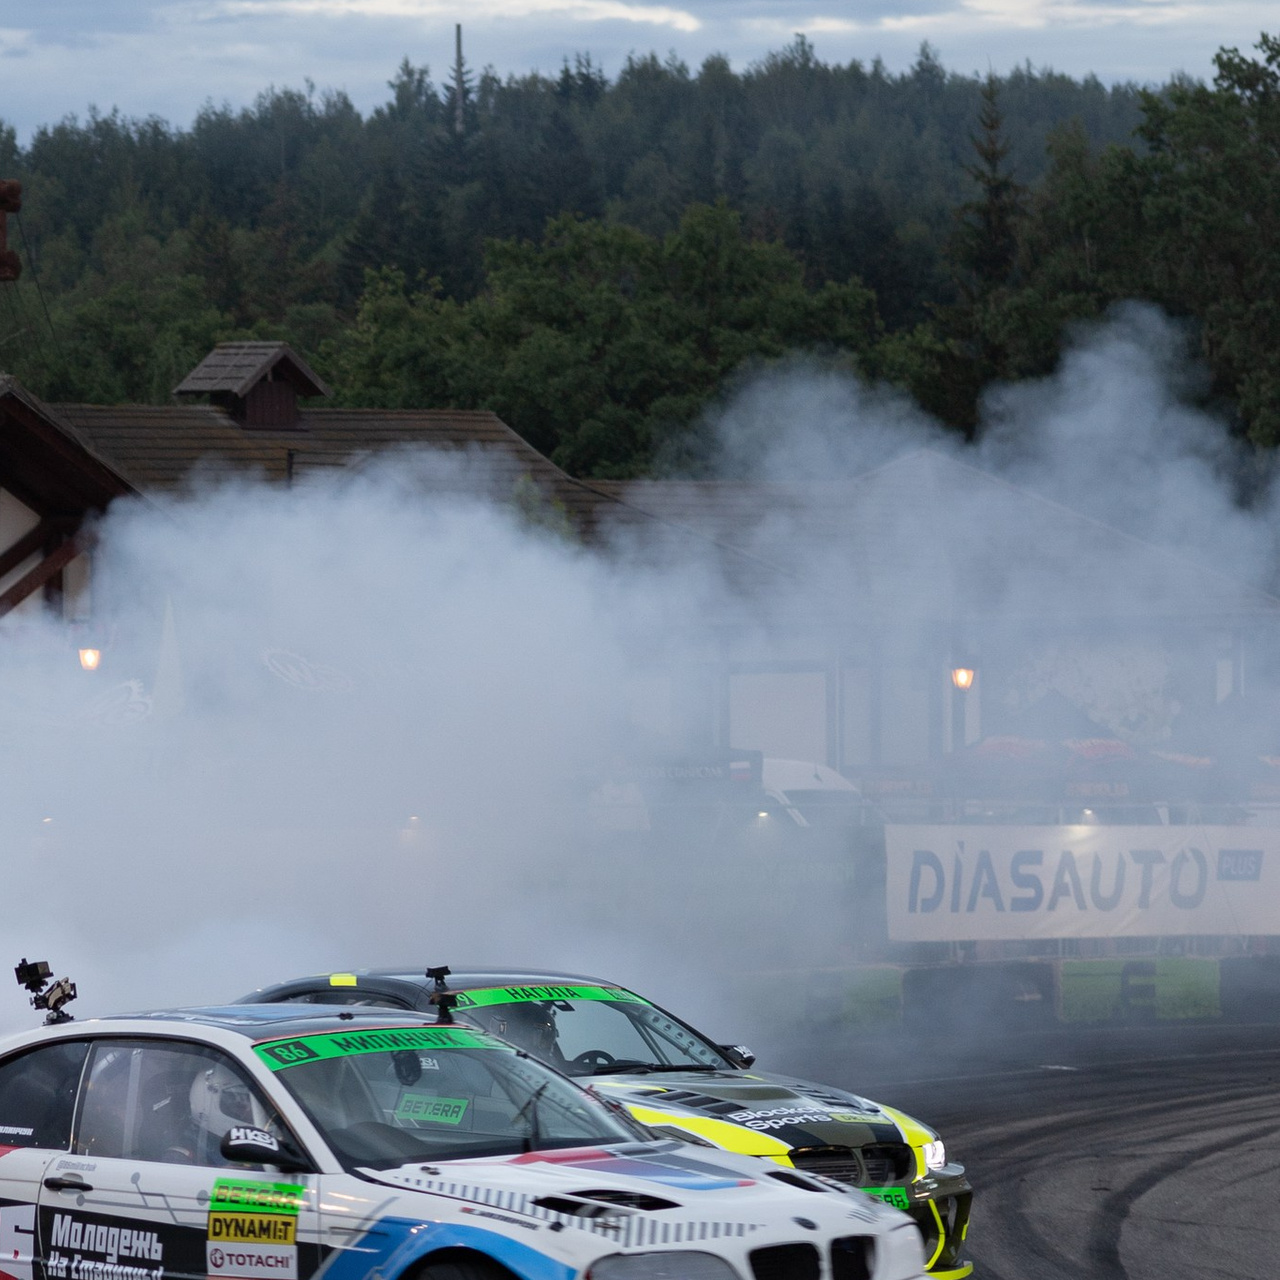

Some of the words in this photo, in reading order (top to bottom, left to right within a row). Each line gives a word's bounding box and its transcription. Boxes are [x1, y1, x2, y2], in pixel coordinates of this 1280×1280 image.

[273, 1043, 310, 1063] 86
[745, 1113, 832, 1130] Sports
[230, 1127, 273, 1146] HKS
[50, 1213, 163, 1264] Молодежь
[48, 1251, 69, 1277] На
[226, 1253, 290, 1268] TOTACHI
